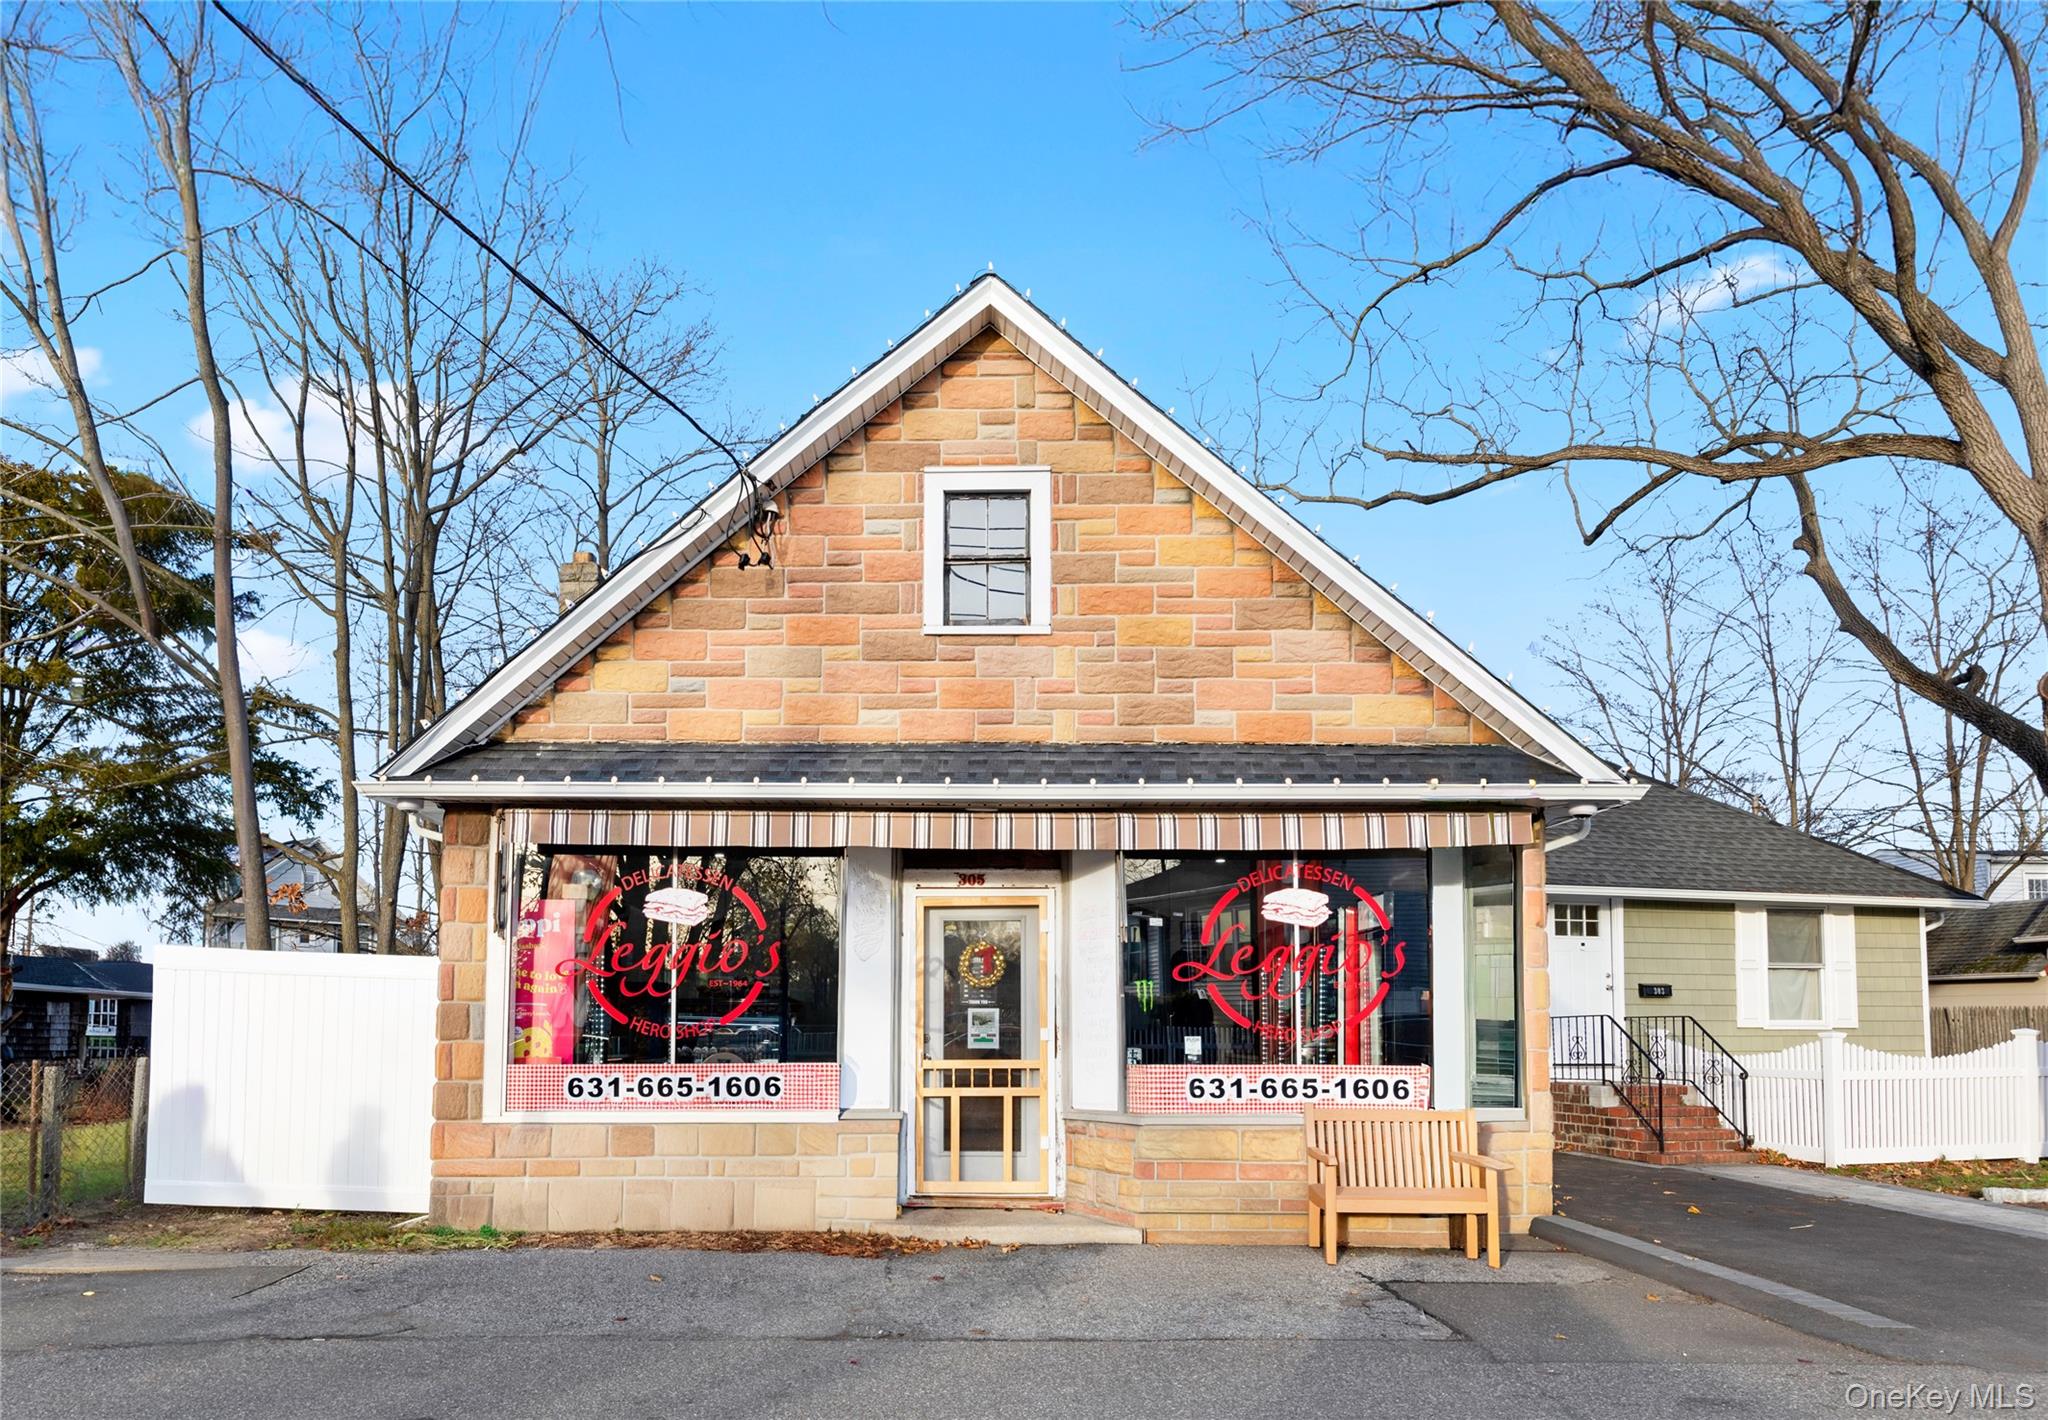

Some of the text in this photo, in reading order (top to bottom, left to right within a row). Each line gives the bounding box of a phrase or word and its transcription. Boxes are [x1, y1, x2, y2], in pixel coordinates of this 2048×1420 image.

[621, 864, 733, 891] DELICATESSEN
[958, 873, 986, 886] 305
[1237, 864, 1354, 892] DELICATESSEN
[555, 921, 781, 998] Leggio's
[1172, 922, 1407, 1001] Leggio's
[629, 1016, 716, 1040] HERO SHOP
[1252, 1020, 1342, 1043] HERO SHOP
[567, 1076, 781, 1098] 631-665-1606
[1189, 1078, 1409, 1100] 631-665-1606
